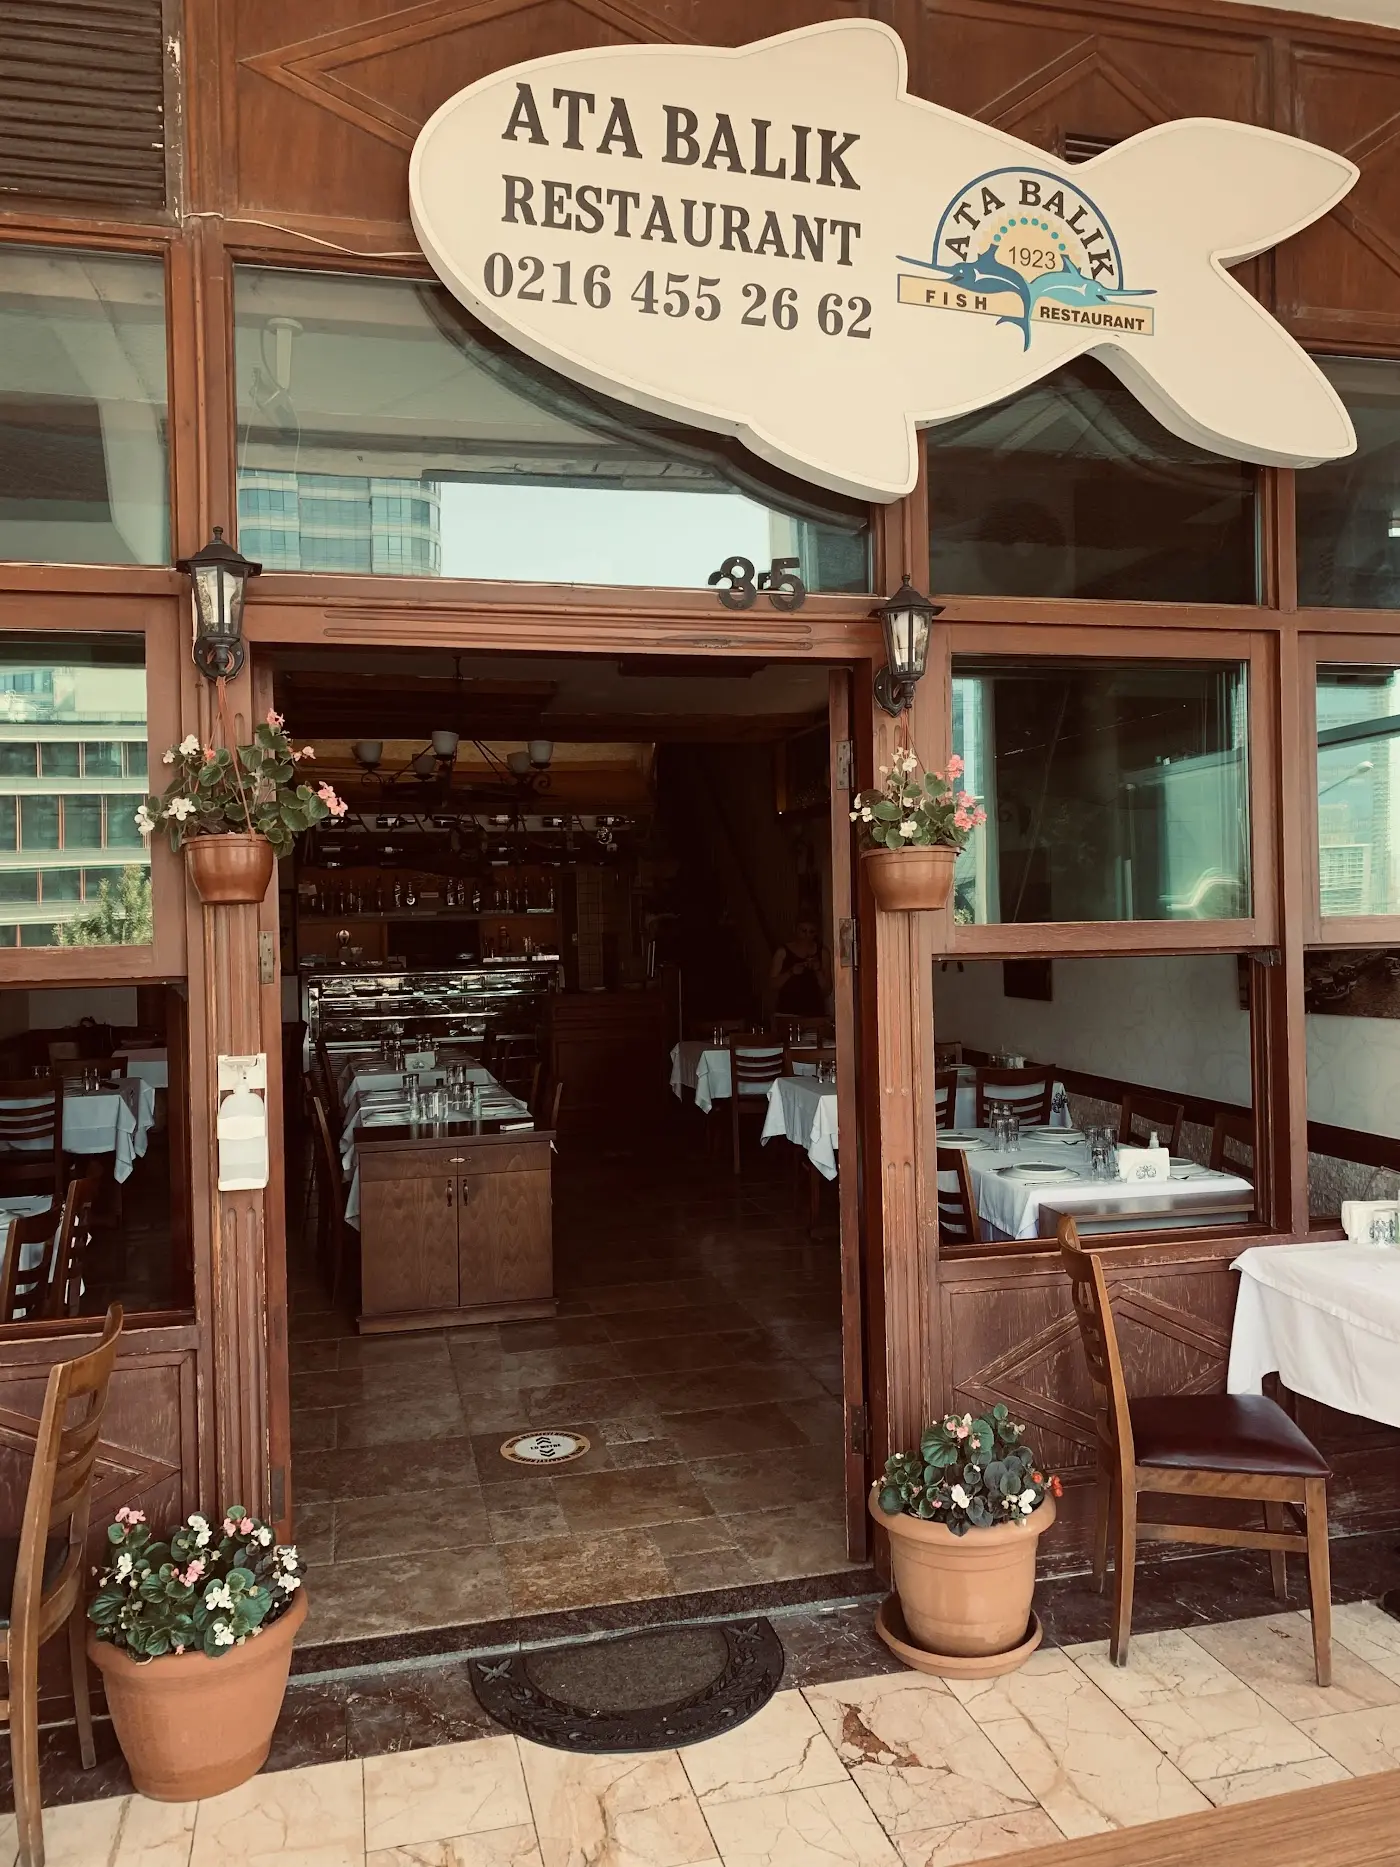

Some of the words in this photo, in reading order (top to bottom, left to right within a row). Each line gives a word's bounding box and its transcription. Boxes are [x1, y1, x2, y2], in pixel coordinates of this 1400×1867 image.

[502, 83, 642, 159] ATA
[662, 105, 860, 190] BALIK
[502, 175, 861, 266] RESTAURANT
[944, 186, 1005, 261] ATA
[1018, 179, 1115, 279] BALIK
[1008, 246, 1056, 270] 1923
[484, 253, 611, 308] 0216
[631, 271, 721, 321] 455
[741, 284, 799, 331] 26
[818, 293, 872, 339] 62
[926, 290, 988, 311] FISH
[1040, 306, 1146, 331] RESTAURANT
[718, 556, 806, 612] 35
